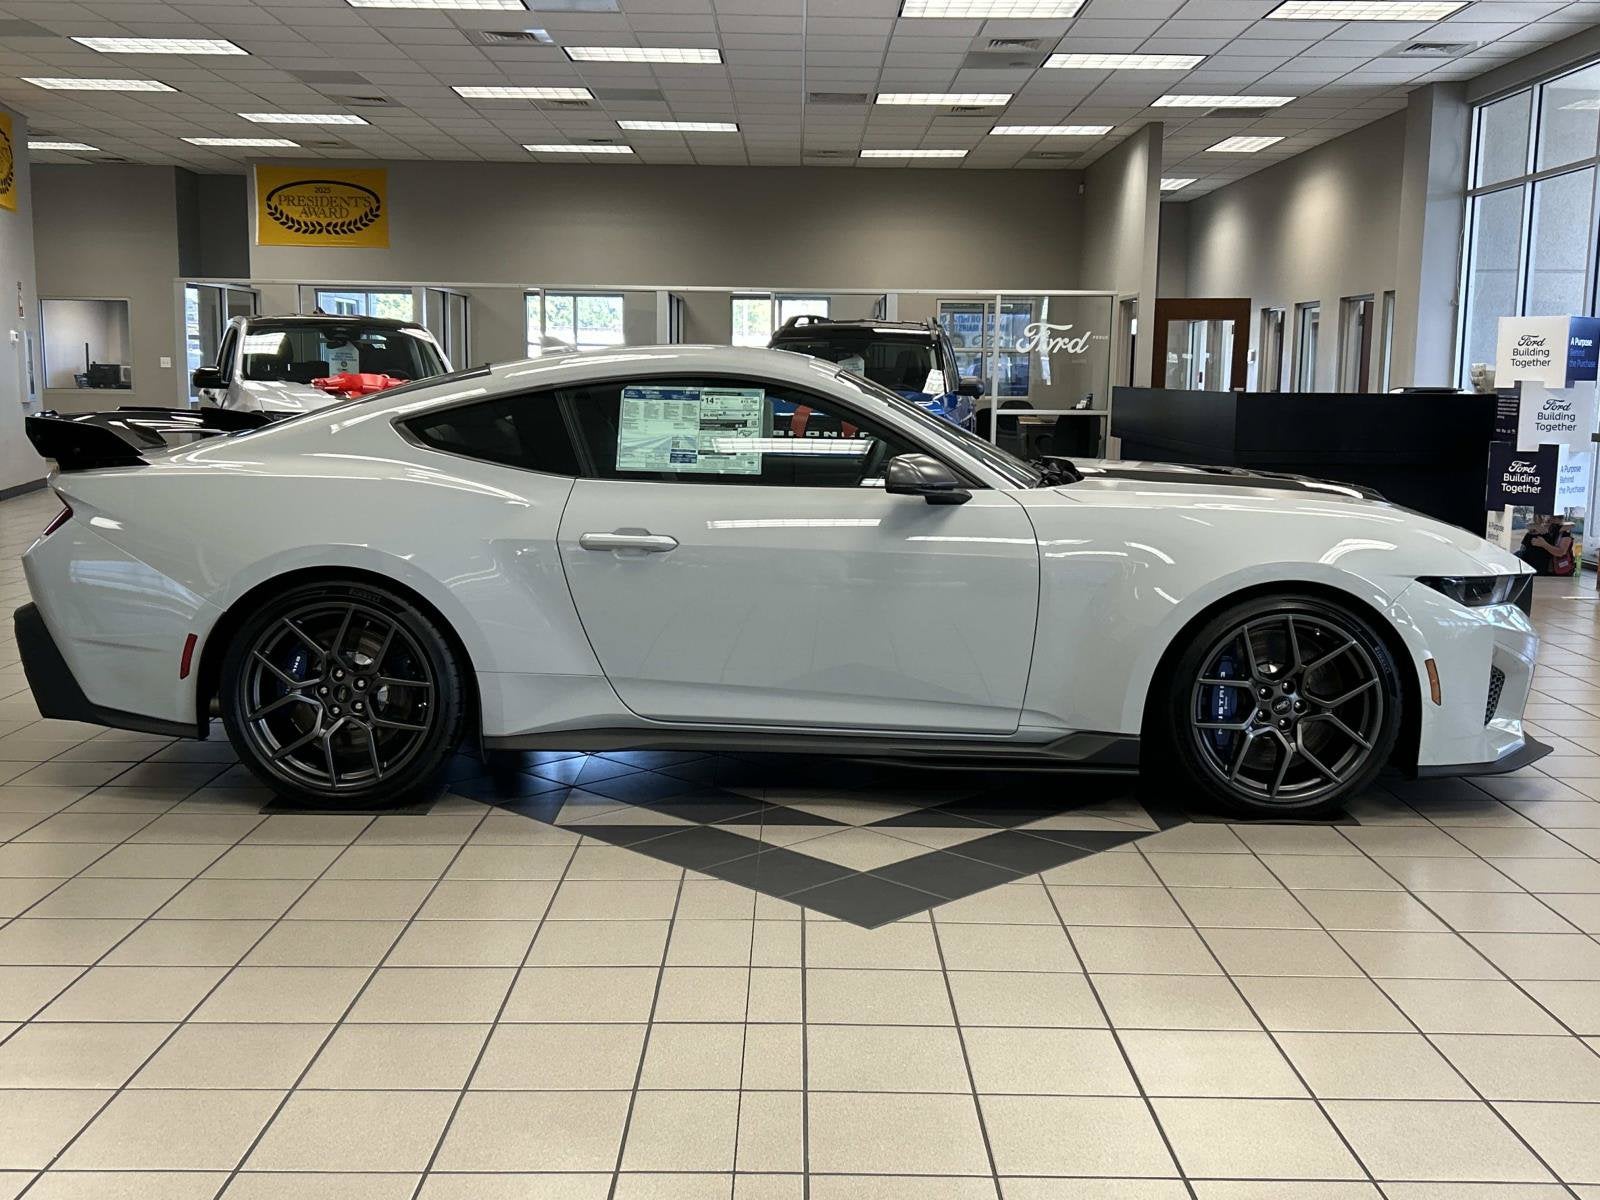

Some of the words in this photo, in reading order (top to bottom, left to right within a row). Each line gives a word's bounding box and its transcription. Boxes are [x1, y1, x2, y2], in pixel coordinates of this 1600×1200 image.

[278, 195, 371, 208] PRESIDENT'S
[299, 207, 350, 219] AWARD
[1015, 322, 1091, 353] Ford
[1517, 334, 1546, 346] Ford
[1571, 337, 1574, 345] A
[1574, 338, 1593, 347] Purpose
[1512, 348, 1550, 358] Building
[1510, 358, 1551, 368] Together
[1542, 398, 1572, 411] Ford
[1537, 411, 1576, 422] Building
[1535, 422, 1577, 432] Together
[1508, 460, 1537, 473] Ford
[1503, 473, 1540, 484] Building
[1501, 483, 1542, 493] Together
